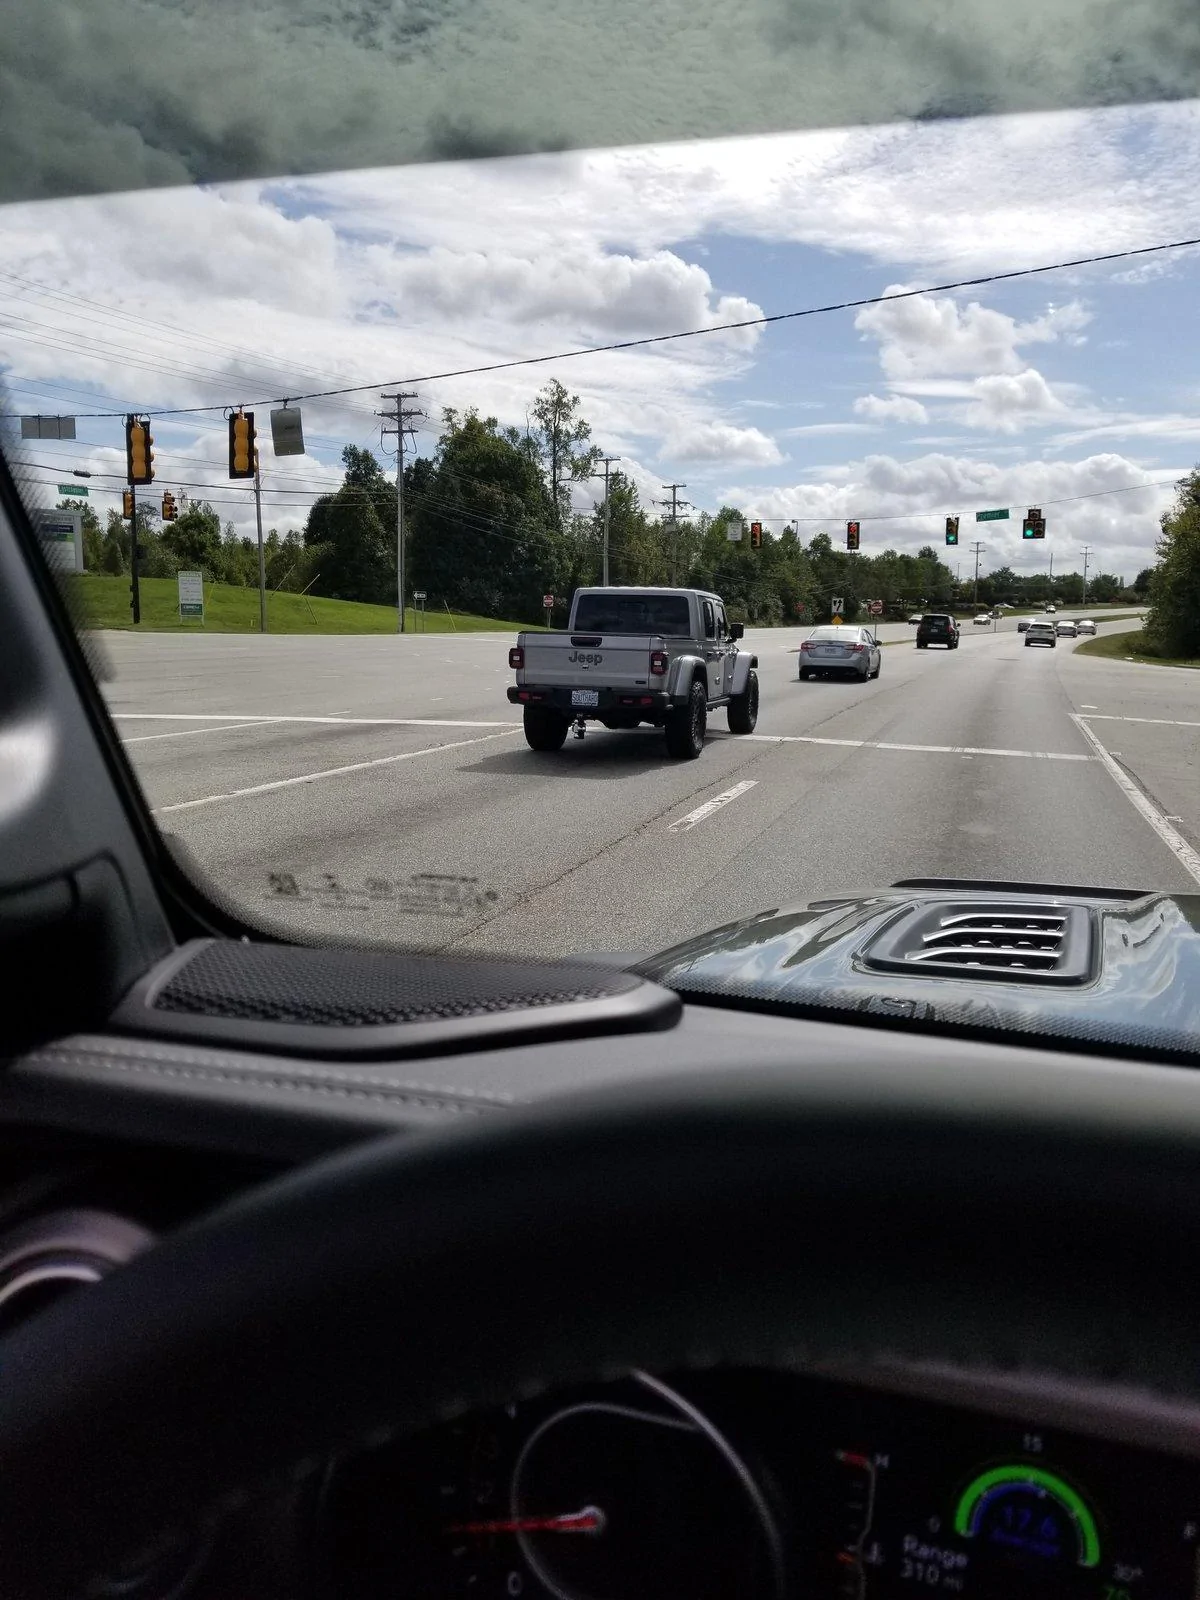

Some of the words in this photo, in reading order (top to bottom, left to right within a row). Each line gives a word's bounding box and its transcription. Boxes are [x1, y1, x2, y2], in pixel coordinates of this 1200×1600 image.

[568, 651, 603, 666] Jeep
[903, 1534, 968, 1569] Range
[507, 1571, 523, 1597] 0
[900, 1557, 940, 1586] 310
